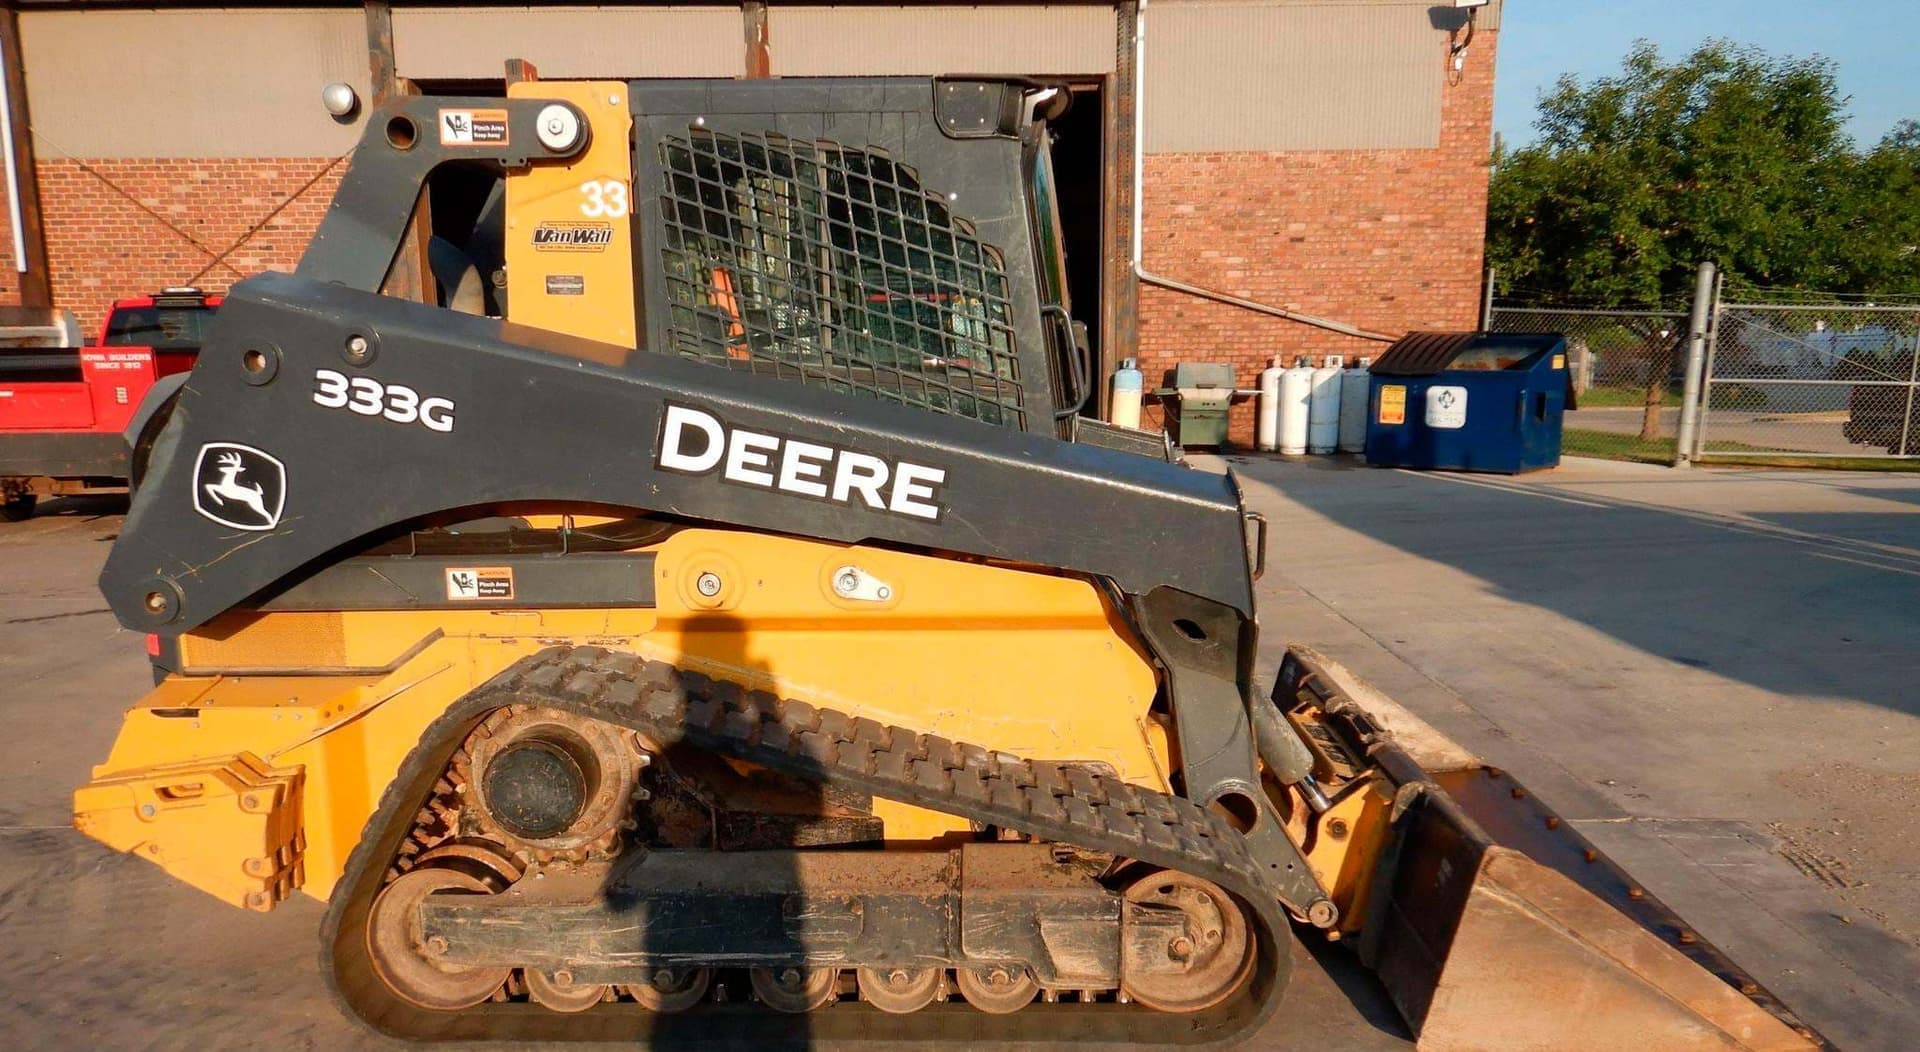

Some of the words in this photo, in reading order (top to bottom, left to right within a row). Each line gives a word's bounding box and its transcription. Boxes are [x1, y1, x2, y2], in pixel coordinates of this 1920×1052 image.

[473, 124, 490, 132] Pinch
[491, 124, 505, 132] Area
[580, 180, 627, 217] 33
[109, 353, 152, 361] BUILDERS
[313, 369, 455, 432] 333G
[660, 405, 946, 520] DEERE
